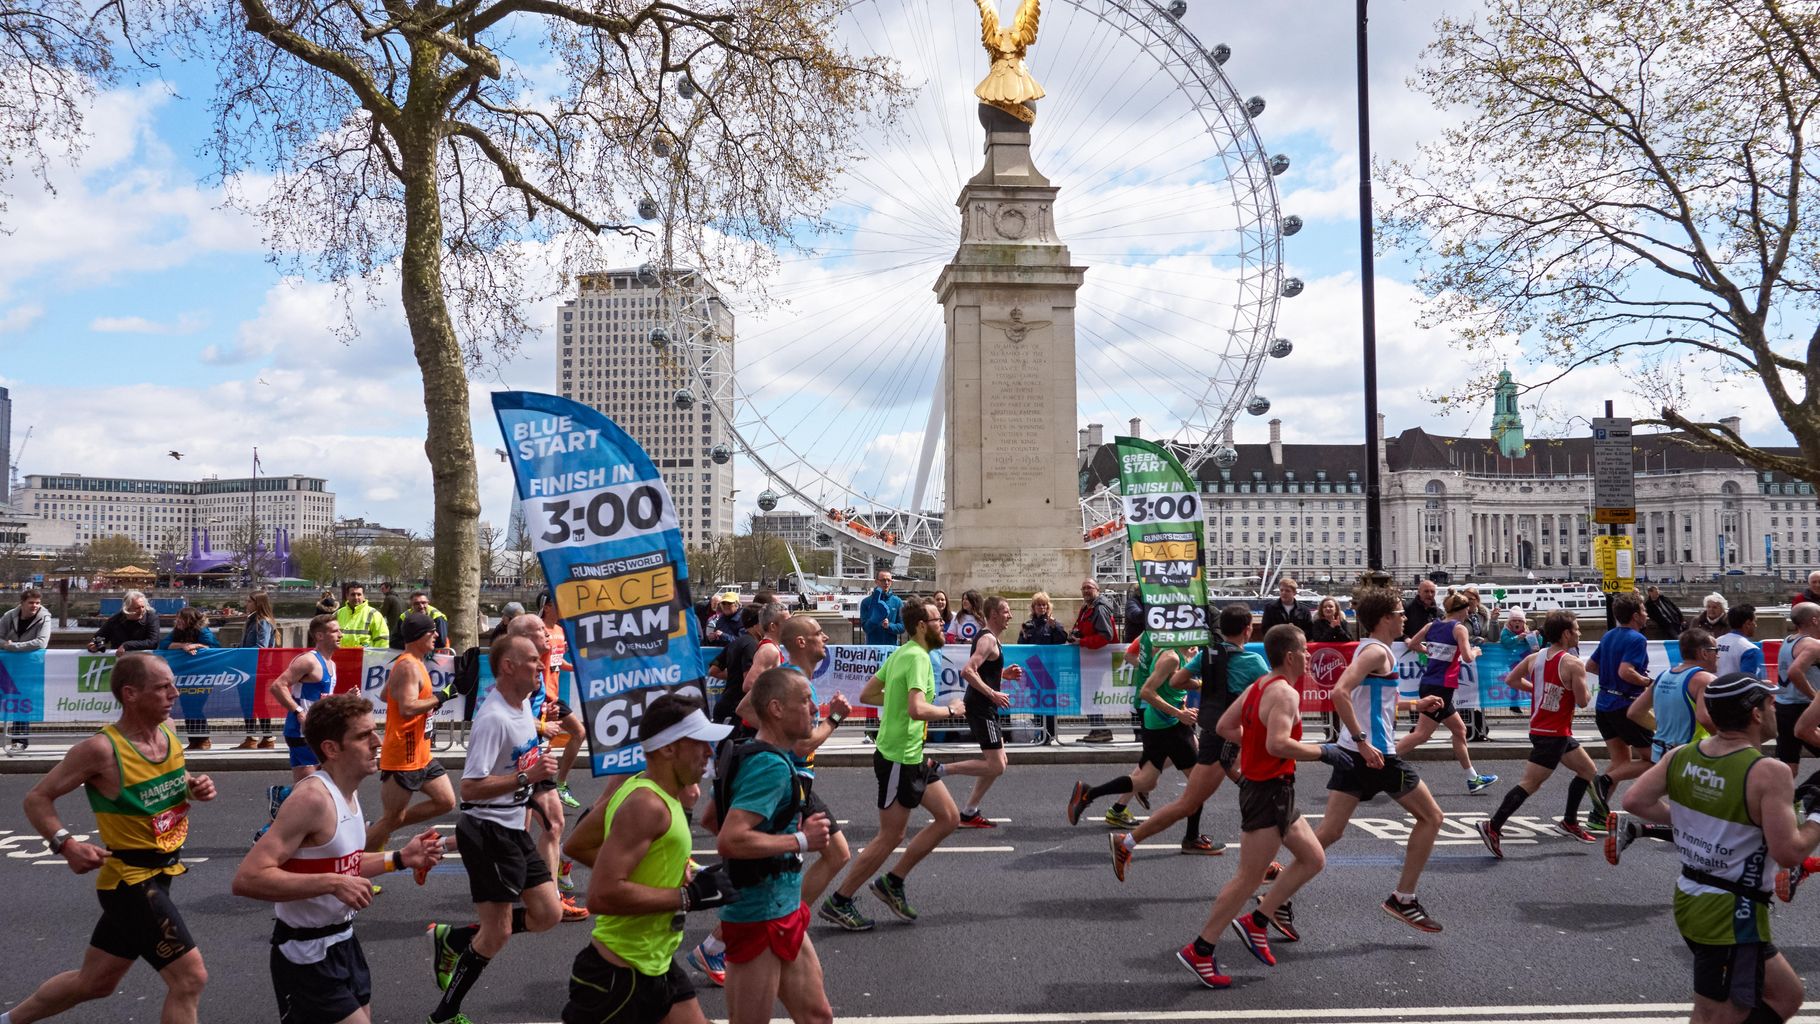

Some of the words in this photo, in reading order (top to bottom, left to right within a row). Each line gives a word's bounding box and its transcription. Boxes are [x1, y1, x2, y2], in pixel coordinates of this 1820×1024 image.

[513, 415, 573, 441] BLUE
[519, 429, 601, 460] START
[1122, 453, 1159, 463] GREEN
[1123, 460, 1168, 474] START
[530, 470, 605, 496] FINISH
[612, 464, 634, 483] IN
[1127, 482, 1168, 495] FINISH
[1171, 481, 1184, 491] IN
[541, 486, 663, 544] 3:00
[1130, 495, 1197, 522] 3:00
[1143, 543, 1195, 559] PACE
[571, 561, 627, 578] RUNNER'S
[627, 555, 662, 569] WORLD
[1142, 561, 1193, 576] TEAM
[576, 571, 670, 610] PACE
[579, 605, 670, 643] TEAM
[1150, 632, 1176, 643] PER
[1178, 630, 1209, 642] MILE
[835, 646, 867, 662] Royal
[869, 650, 886, 662] Air
[1312, 653, 1343, 680] Virgin
[589, 665, 681, 699] RUNNING
[833, 672, 844, 680] THE
[56, 697, 112, 713] Holiday
[1715, 843, 1735, 856] for
[1694, 851, 1729, 869] health
